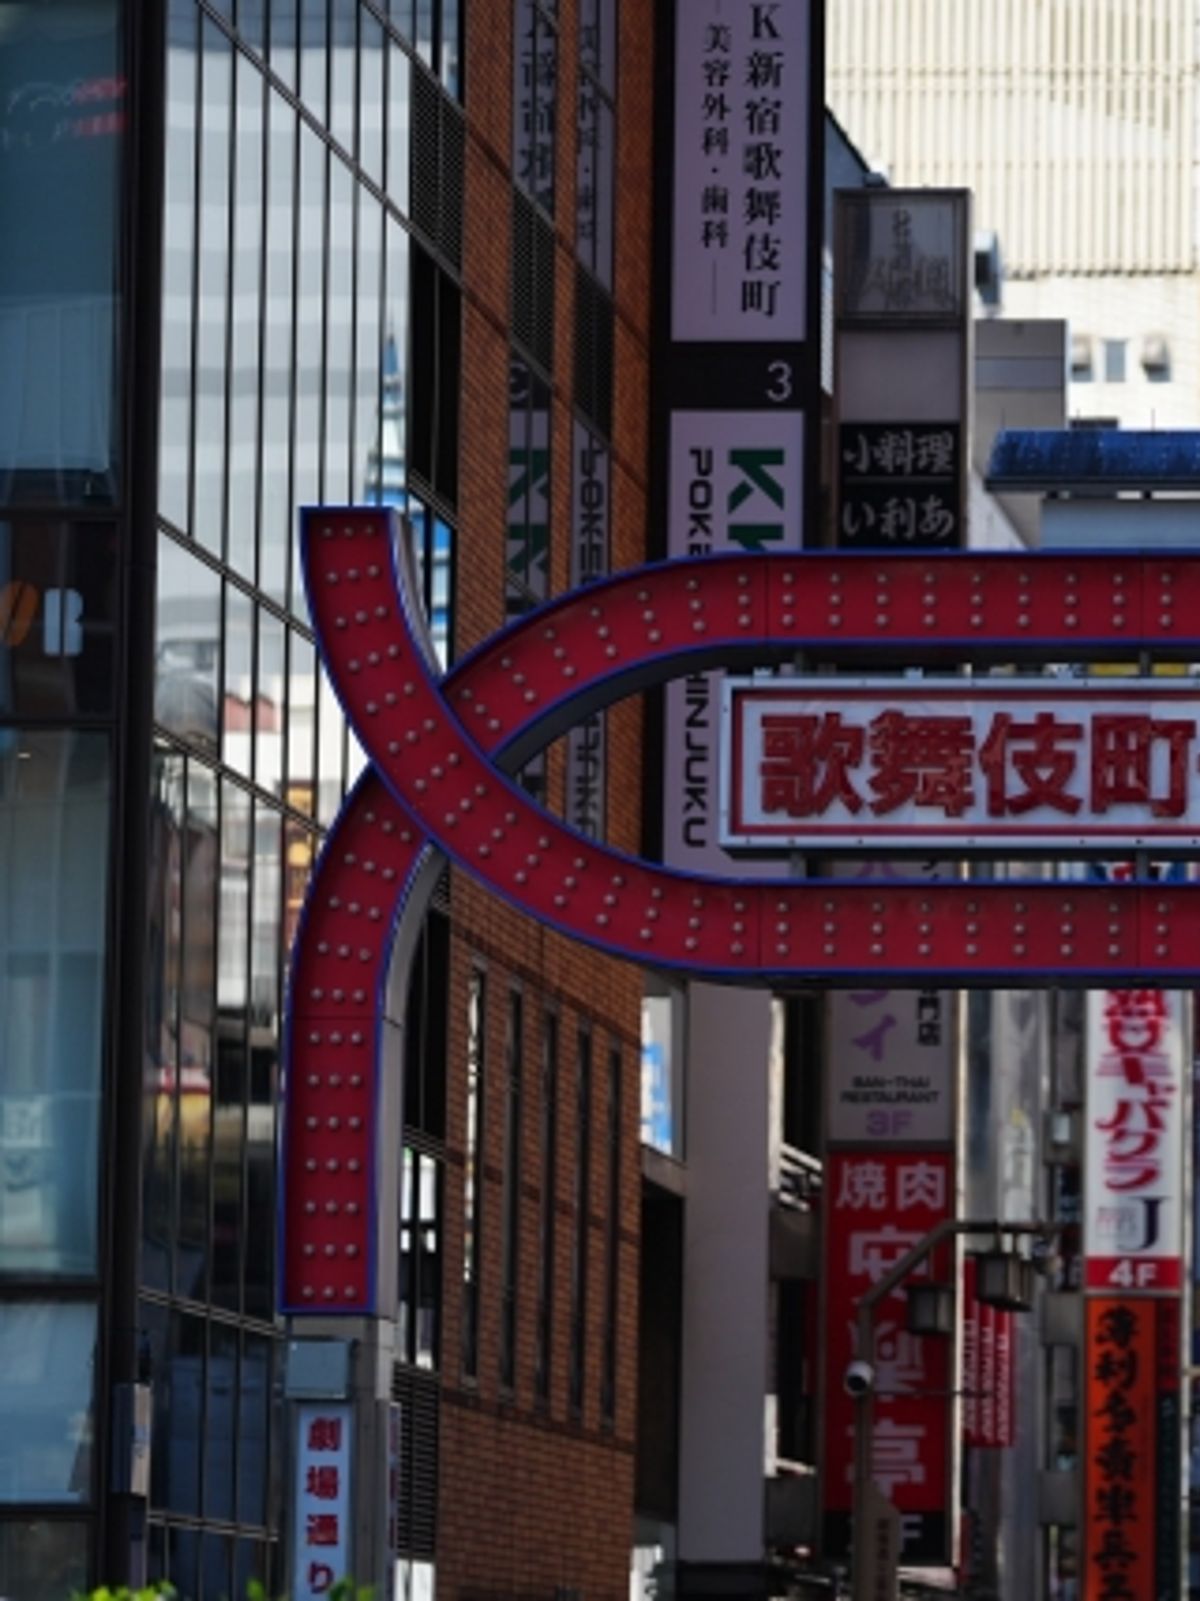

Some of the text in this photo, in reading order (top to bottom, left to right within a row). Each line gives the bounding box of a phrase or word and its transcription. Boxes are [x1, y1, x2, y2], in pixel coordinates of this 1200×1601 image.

[701, 24, 732, 250] 美容外科・歯科
[767, 361, 793, 401] 3
[843, 432, 954, 474] 小料理
[683, 671, 709, 848] HINJUKU
[917, 989, 942, 1046] 門店
[865, 1109, 913, 1137] 3F
[836, 1161, 946, 1210] 焼肉
[1108, 1259, 1157, 1288] 4F
[306, 1417, 342, 1596] 劇場通り
